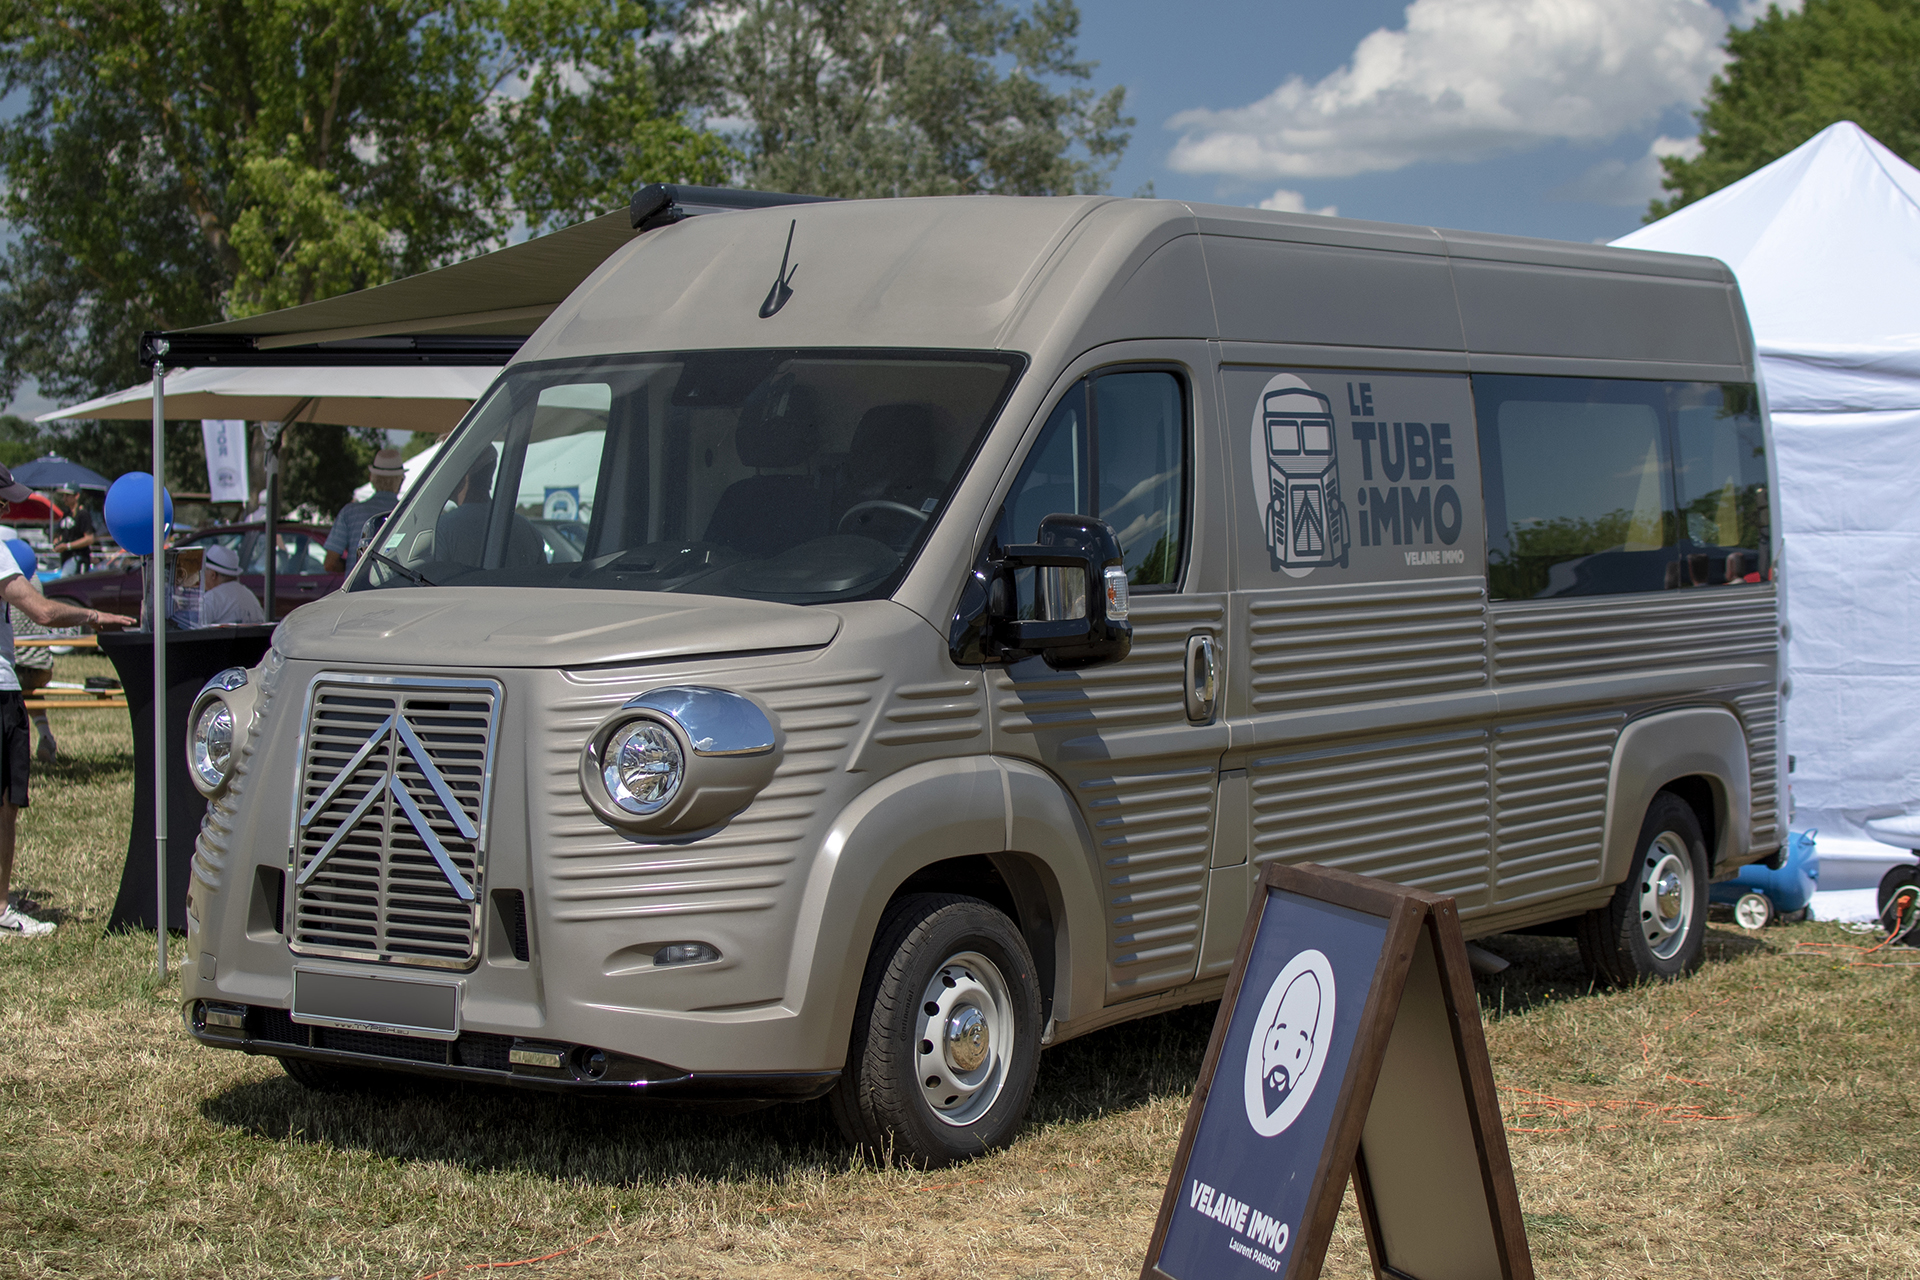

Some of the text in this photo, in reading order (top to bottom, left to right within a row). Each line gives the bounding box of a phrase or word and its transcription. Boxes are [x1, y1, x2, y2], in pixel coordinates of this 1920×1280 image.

[1346, 382, 1374, 416] LE
[1351, 421, 1455, 482] TUBE
[1358, 484, 1462, 546] iMMO
[1404, 549, 1465, 566] VELAINE IMMO
[900, 990, 914, 1042] Continental
[1190, 1179, 1289, 1254] VELAINE IMMO
[1229, 1236, 1281, 1273] Laurent PARISOT
